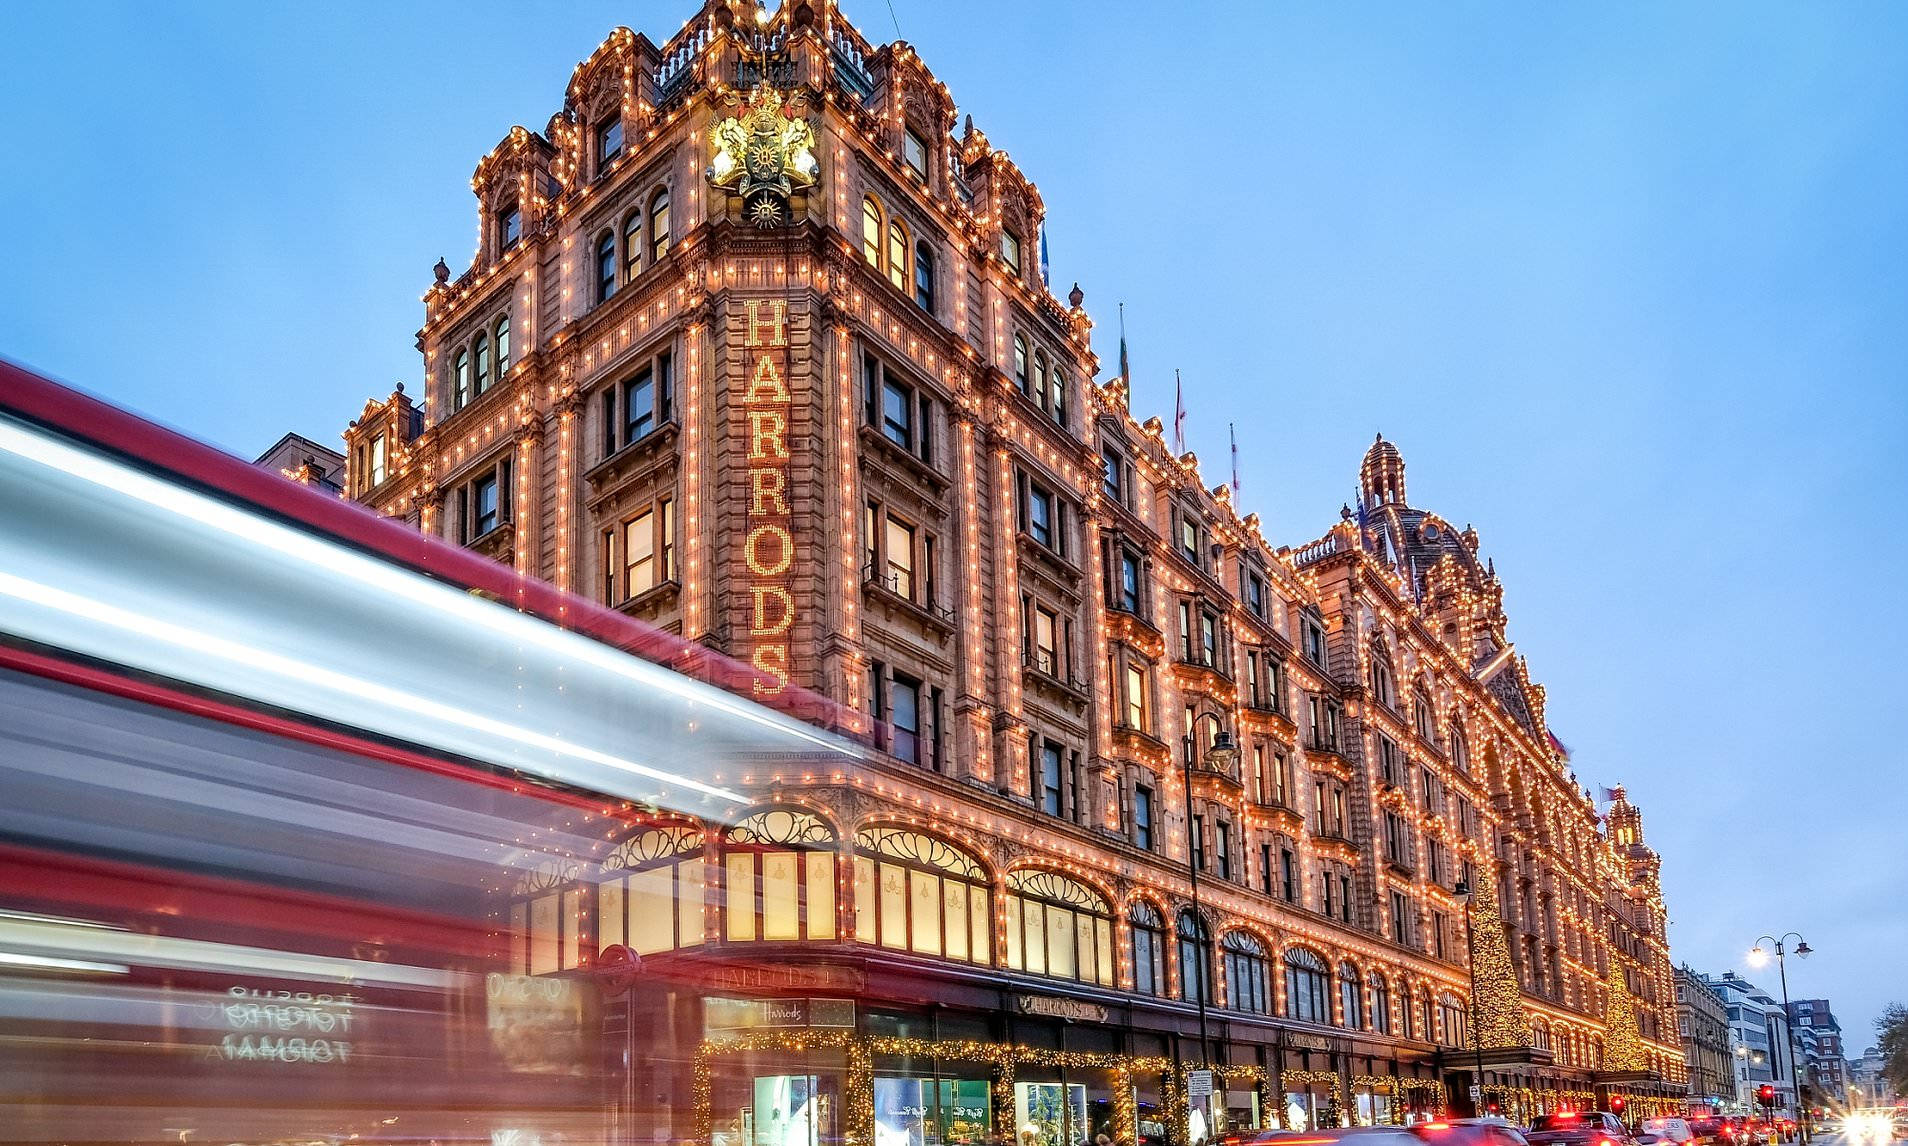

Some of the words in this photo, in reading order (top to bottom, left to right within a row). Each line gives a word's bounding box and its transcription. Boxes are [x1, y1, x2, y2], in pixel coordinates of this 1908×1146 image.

[743, 299, 795, 696] HARRODS
[763, 1001, 802, 1022] Harrods
[1035, 997, 1082, 1017] HARRODS
